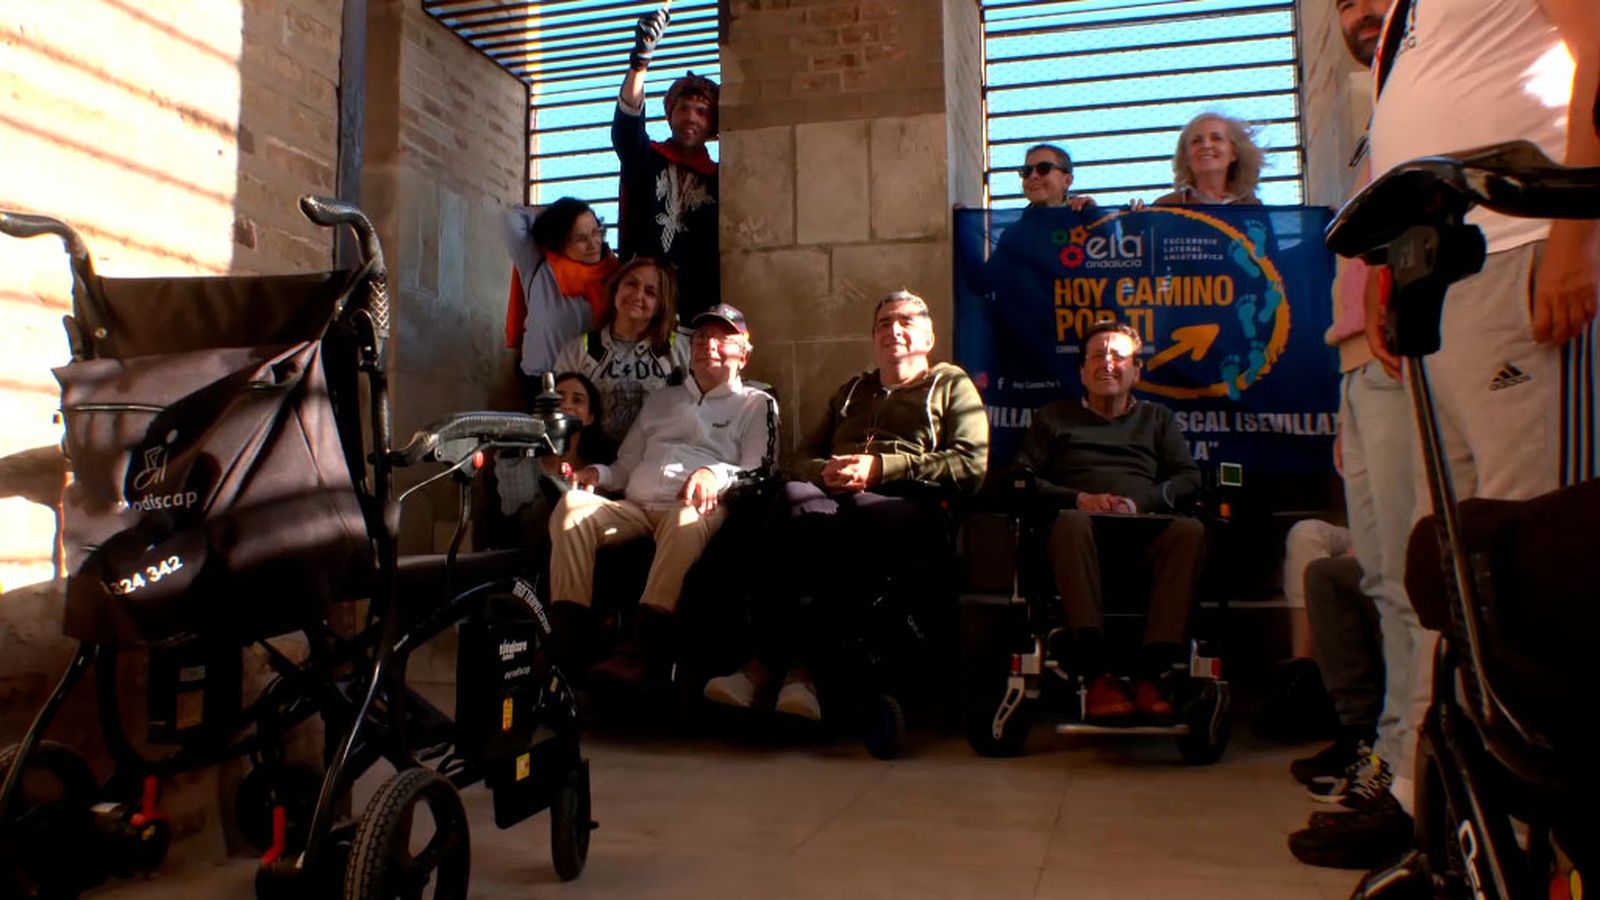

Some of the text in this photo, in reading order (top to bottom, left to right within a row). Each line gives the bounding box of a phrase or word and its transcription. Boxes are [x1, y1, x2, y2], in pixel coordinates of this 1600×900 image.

[1086, 232, 1143, 259] ela
[1054, 275, 1234, 307] HOY CAMINO
[1124, 308, 1154, 343] TI
[146, 554, 184, 583] 342
